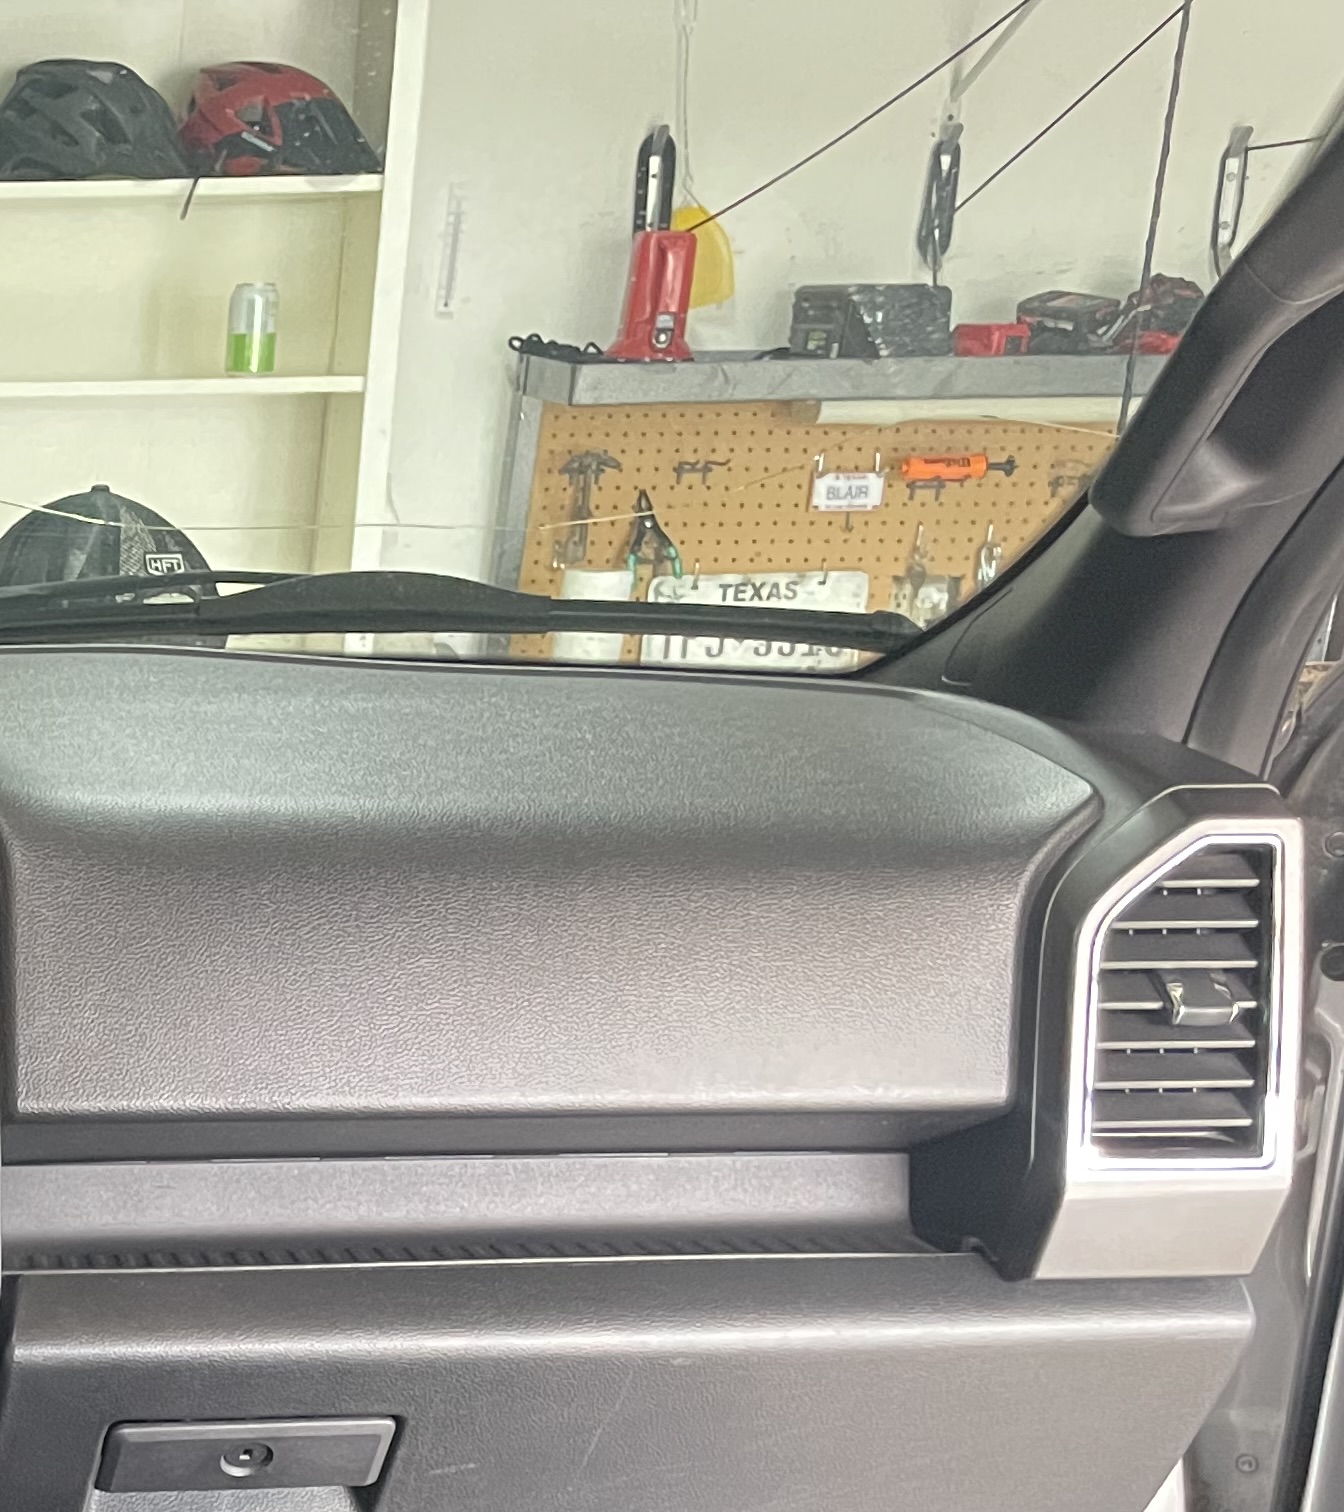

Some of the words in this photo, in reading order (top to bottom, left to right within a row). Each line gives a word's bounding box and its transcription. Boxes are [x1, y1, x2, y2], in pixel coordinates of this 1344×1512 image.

[826, 484, 869, 500] BLAIR
[151, 559, 180, 573] HFT
[719, 581, 799, 602] TEXAS
